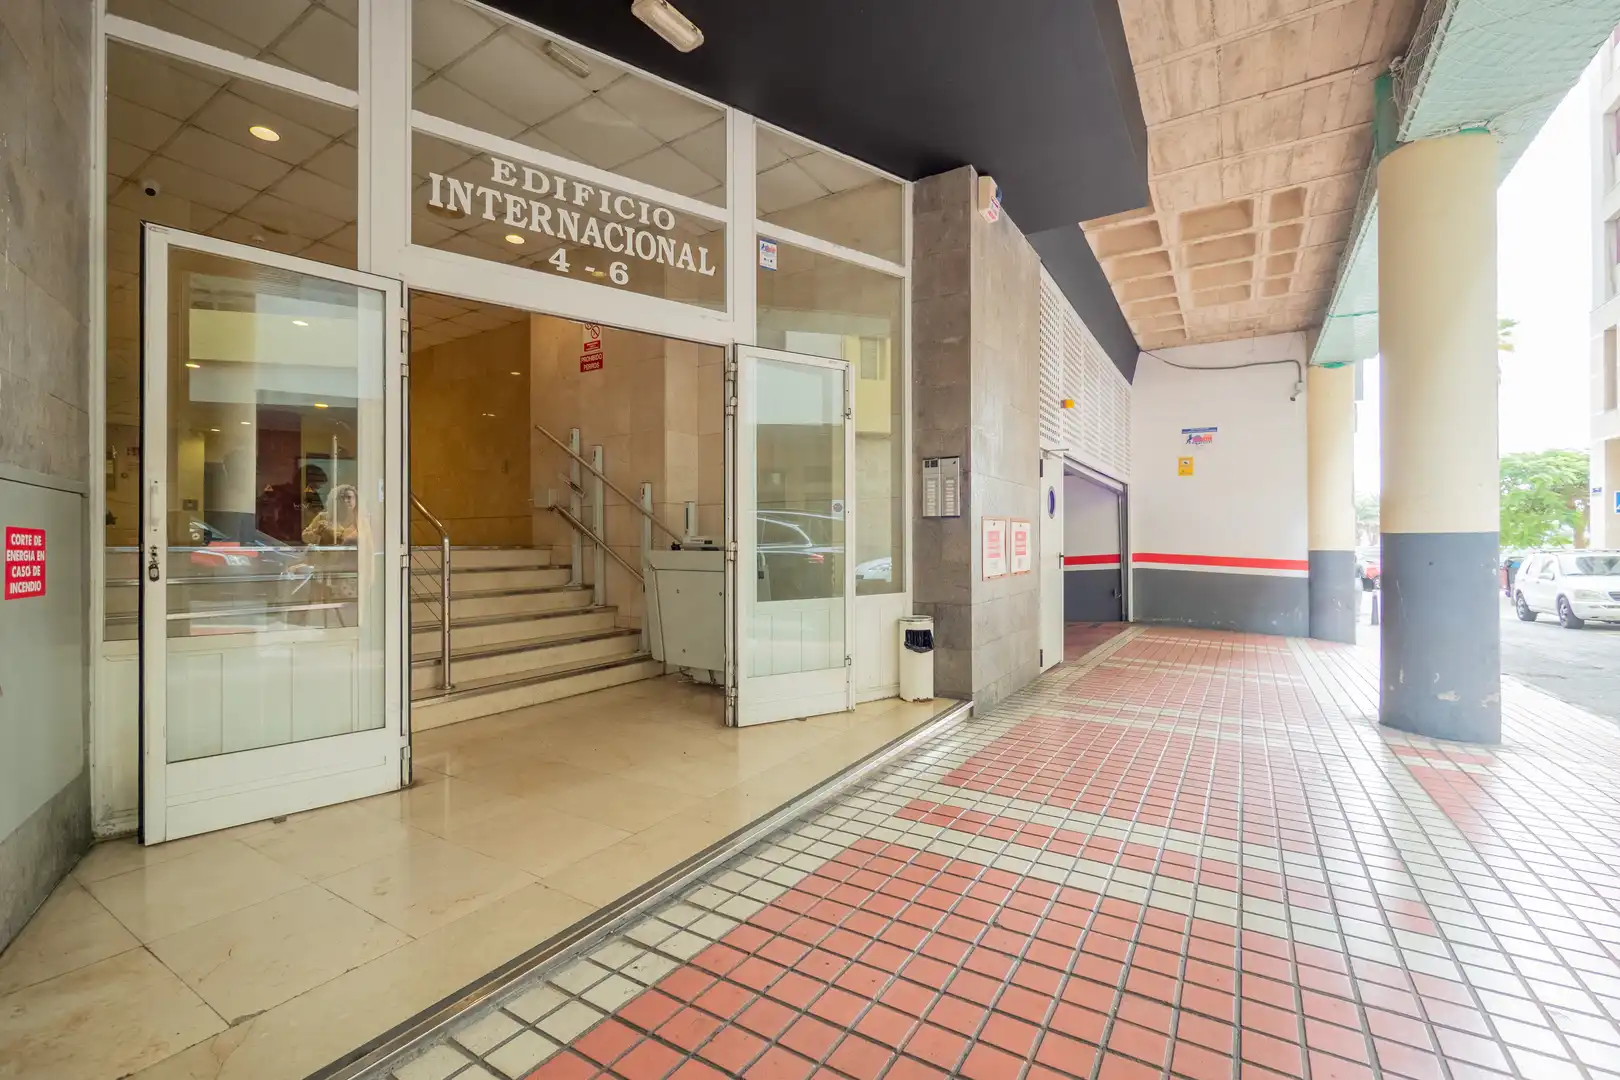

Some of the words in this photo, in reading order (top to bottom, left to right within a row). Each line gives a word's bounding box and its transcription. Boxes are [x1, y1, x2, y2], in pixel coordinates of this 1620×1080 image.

[491, 157, 676, 231] EDIFICIO
[428, 172, 716, 276] INTERNACIONAL
[548, 248, 571, 273] 4
[609, 261, 629, 285] 6
[11, 533, 32, 546] CORTE
[34, 535, 42, 546] DE
[6, 549, 35, 561] ENERGIA
[37, 550, 44, 561] EN
[12, 566, 31, 578] CASO
[33, 566, 41, 576] DE
[10, 581, 41, 594] INCENDIO
